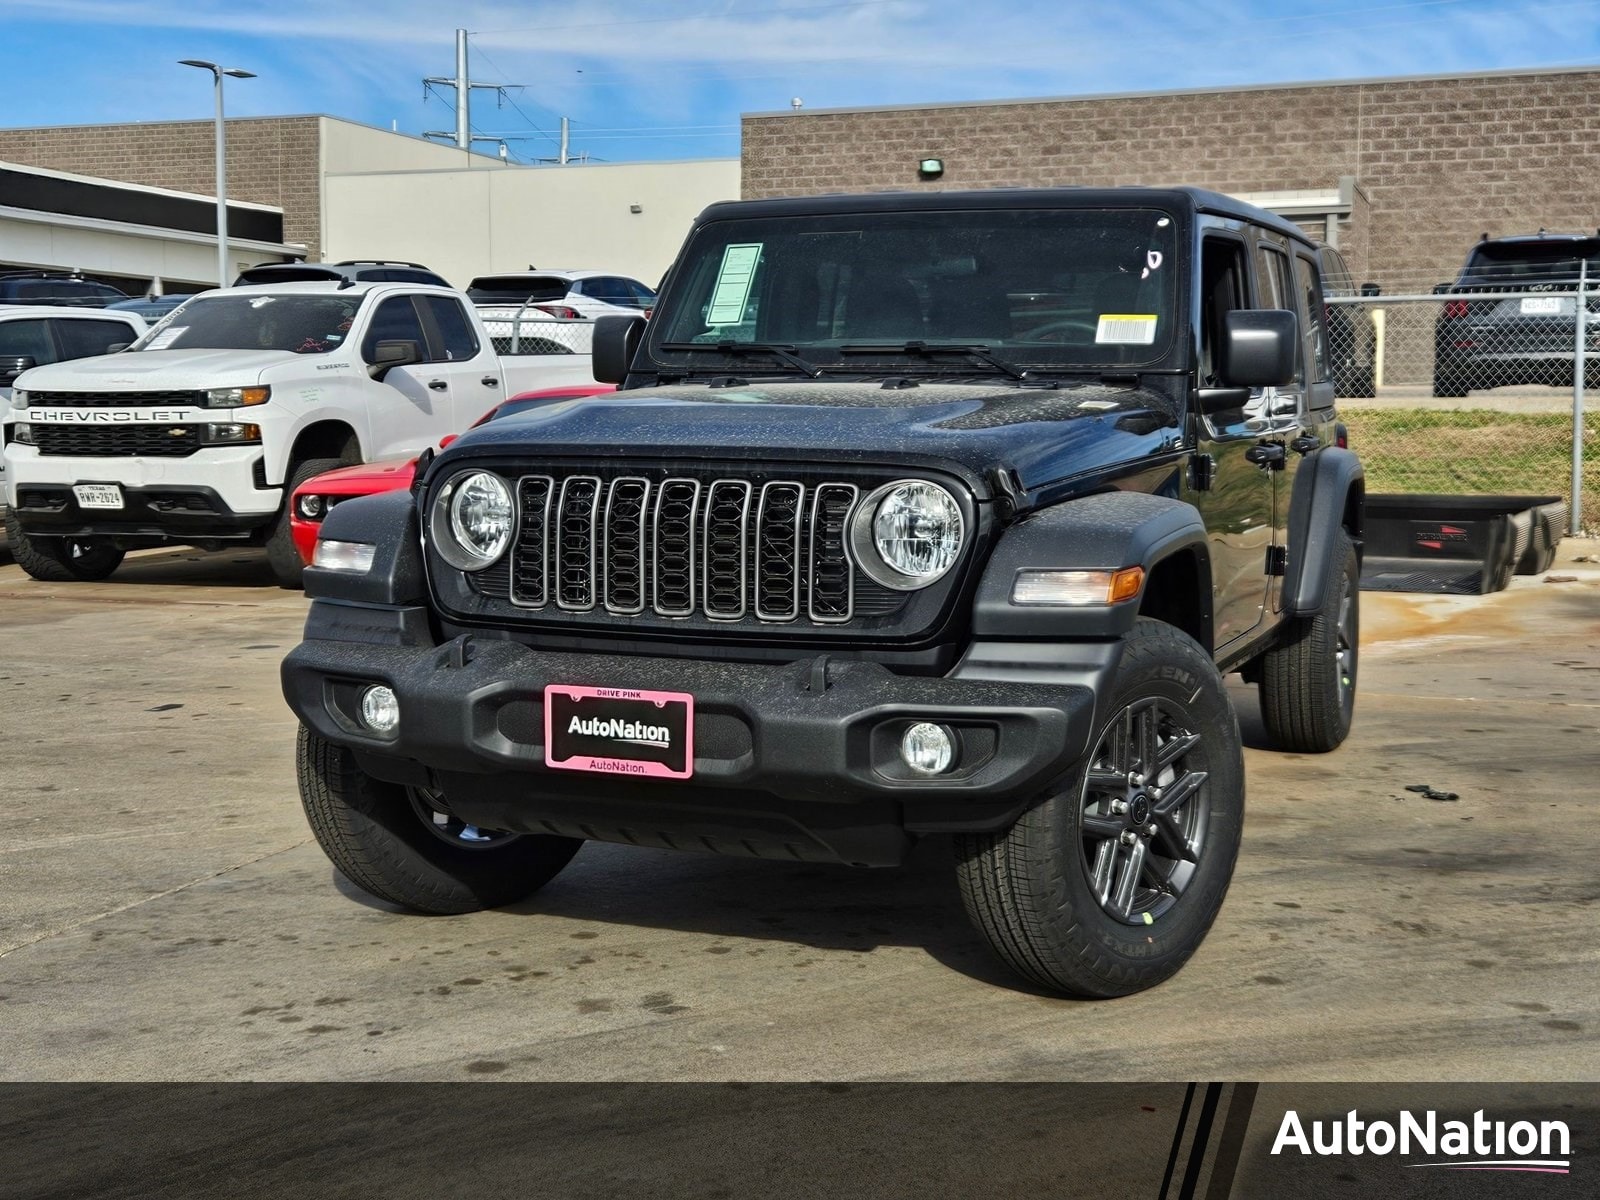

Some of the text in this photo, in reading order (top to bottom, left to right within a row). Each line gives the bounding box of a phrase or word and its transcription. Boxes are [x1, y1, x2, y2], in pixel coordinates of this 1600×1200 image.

[30, 411, 190, 421] CHEVROLET
[596, 688, 642, 699] DRIVE PINK
[568, 715, 671, 742] AutoNation
